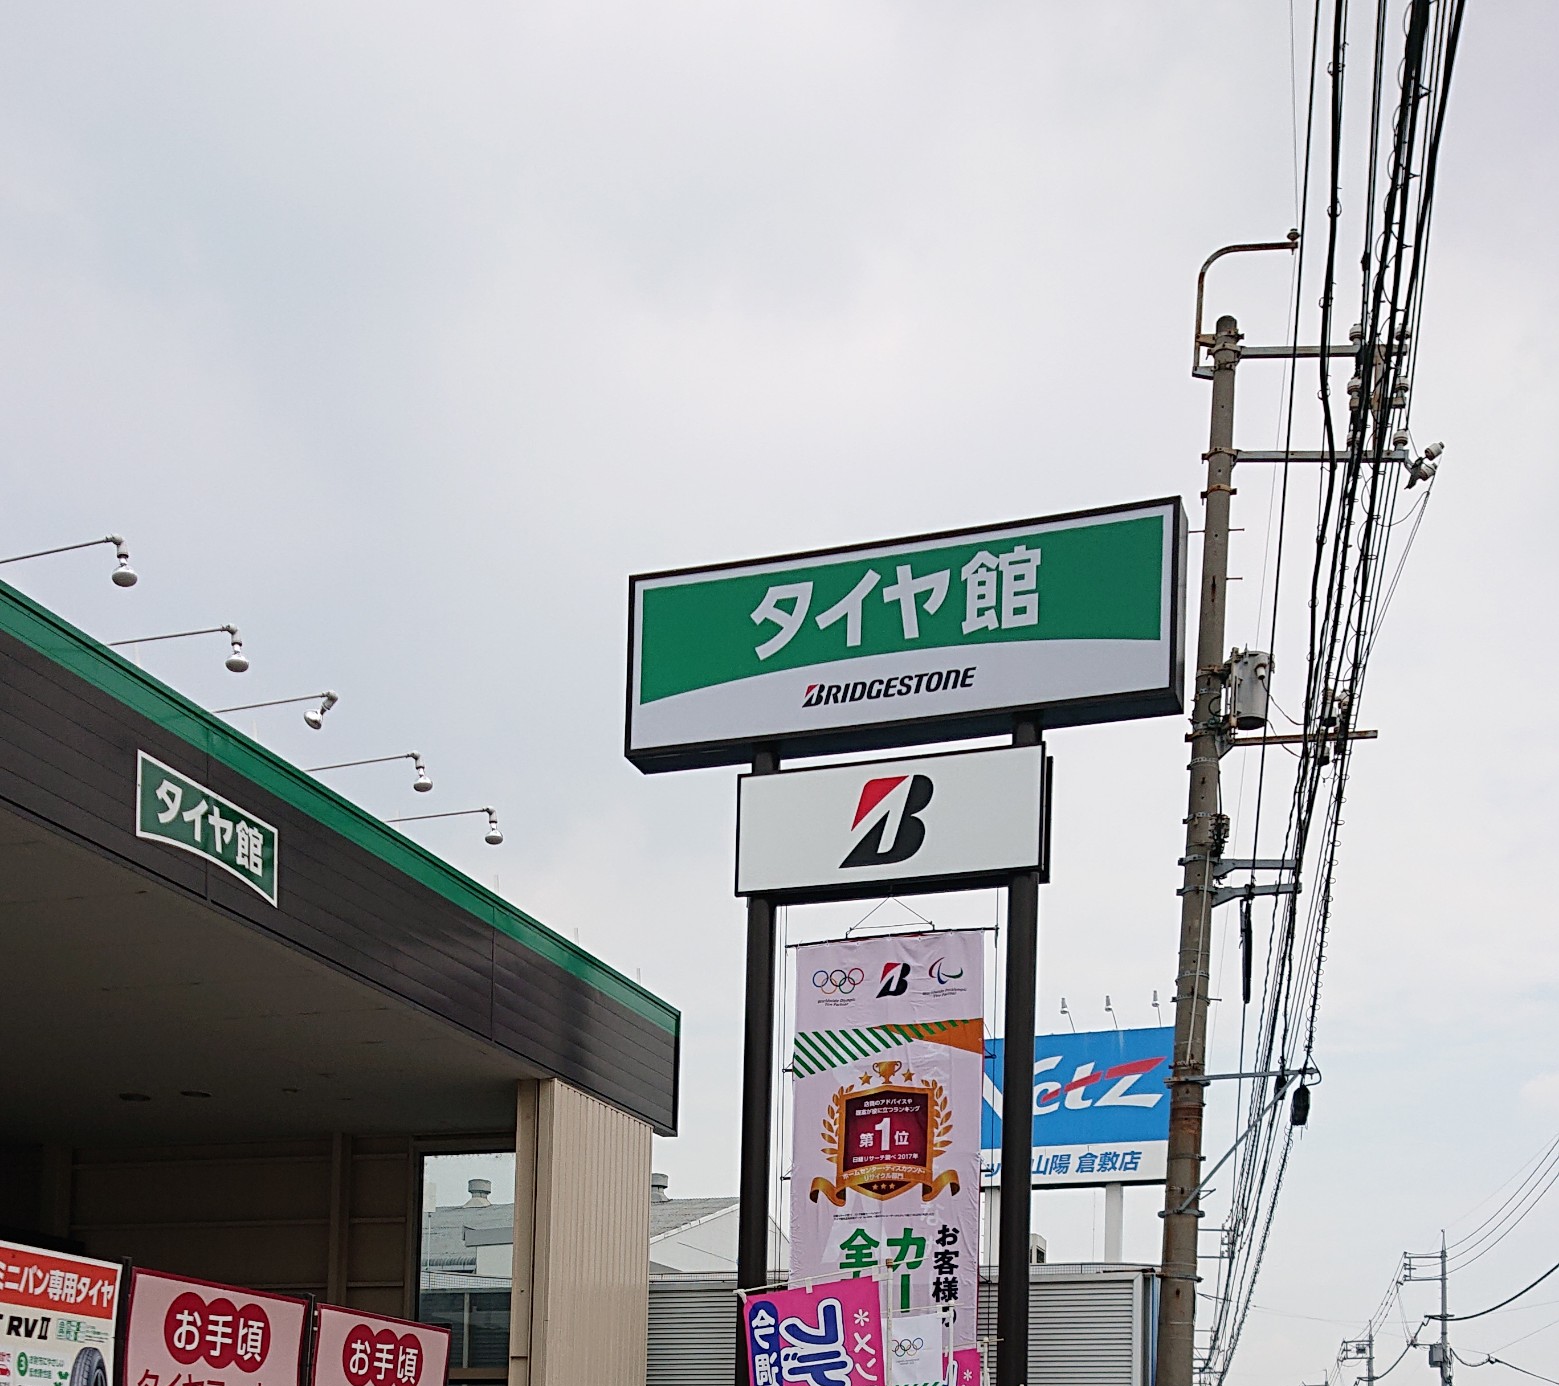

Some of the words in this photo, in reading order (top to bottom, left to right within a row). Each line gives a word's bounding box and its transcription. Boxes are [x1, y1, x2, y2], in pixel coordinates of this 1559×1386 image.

[750, 545, 1042, 660] タイヤ館
[802, 667, 976, 708] BRIDGESTONE
[155, 779, 264, 877] タイヤ館
[859, 1117, 909, 1151] 第1位
[1075, 1151, 1142, 1174] 倉敷店
[173, 1309, 264, 1362] お手頃
